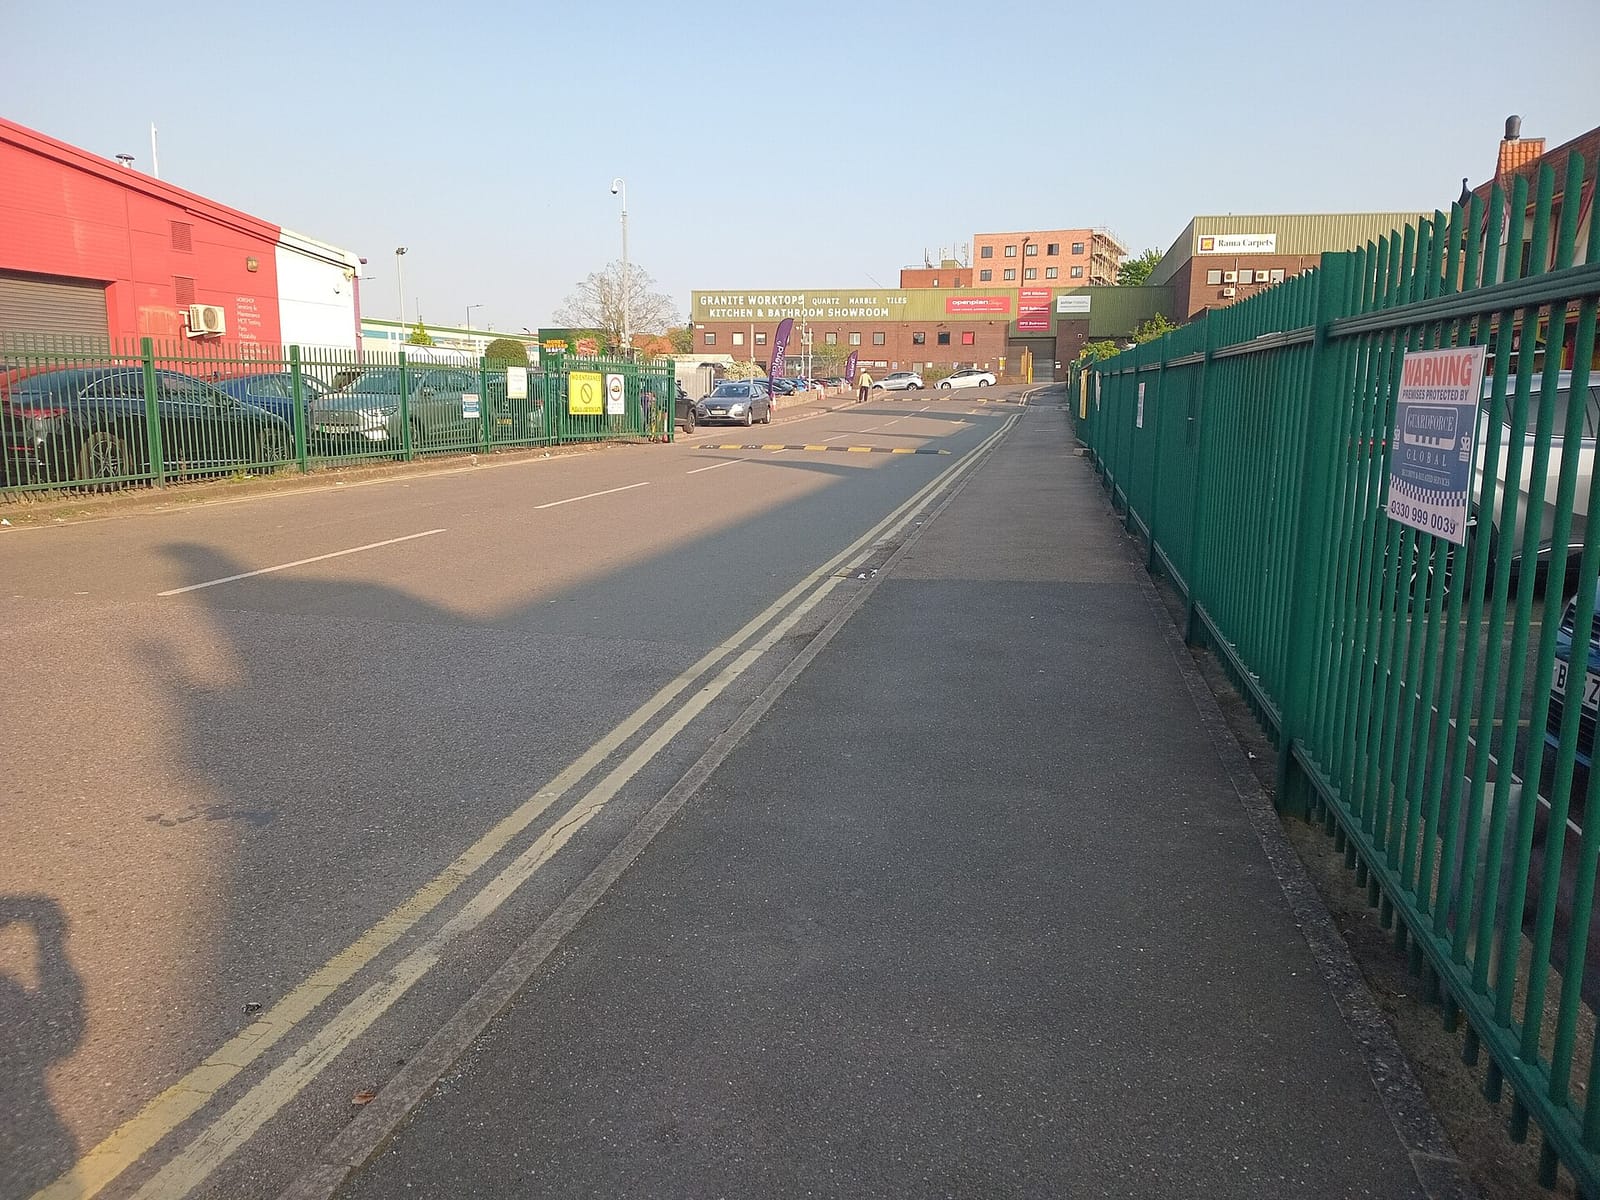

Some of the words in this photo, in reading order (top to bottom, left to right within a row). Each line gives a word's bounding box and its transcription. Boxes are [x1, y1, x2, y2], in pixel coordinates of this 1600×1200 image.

[1218, 239, 1241, 247] Rama
[1242, 239, 1274, 248] Carpets
[700, 295, 744, 306] GRANITE
[747, 295, 804, 306] WORKTOPS
[812, 297, 840, 305] QUARTZ
[848, 297, 877, 305] MARBLE
[709, 308, 753, 317] KITCHEN
[757, 308, 764, 317] &
[768, 308, 824, 317] BATHROOM
[827, 308, 889, 317] SHOWROOM
[1404, 353, 1473, 387] WARNING
[1402, 389, 1426, 400] PREMISES
[1426, 389, 1459, 401] PROTECTED
[1459, 389, 1469, 401] BY
[1407, 413, 1455, 432] GUARDFORCE
[1406, 448, 1447, 467] GLOBAL
[1390, 500, 1410, 519] 0330
[1411, 507, 1428, 526] 999
[1430, 513, 1456, 535] 0039
